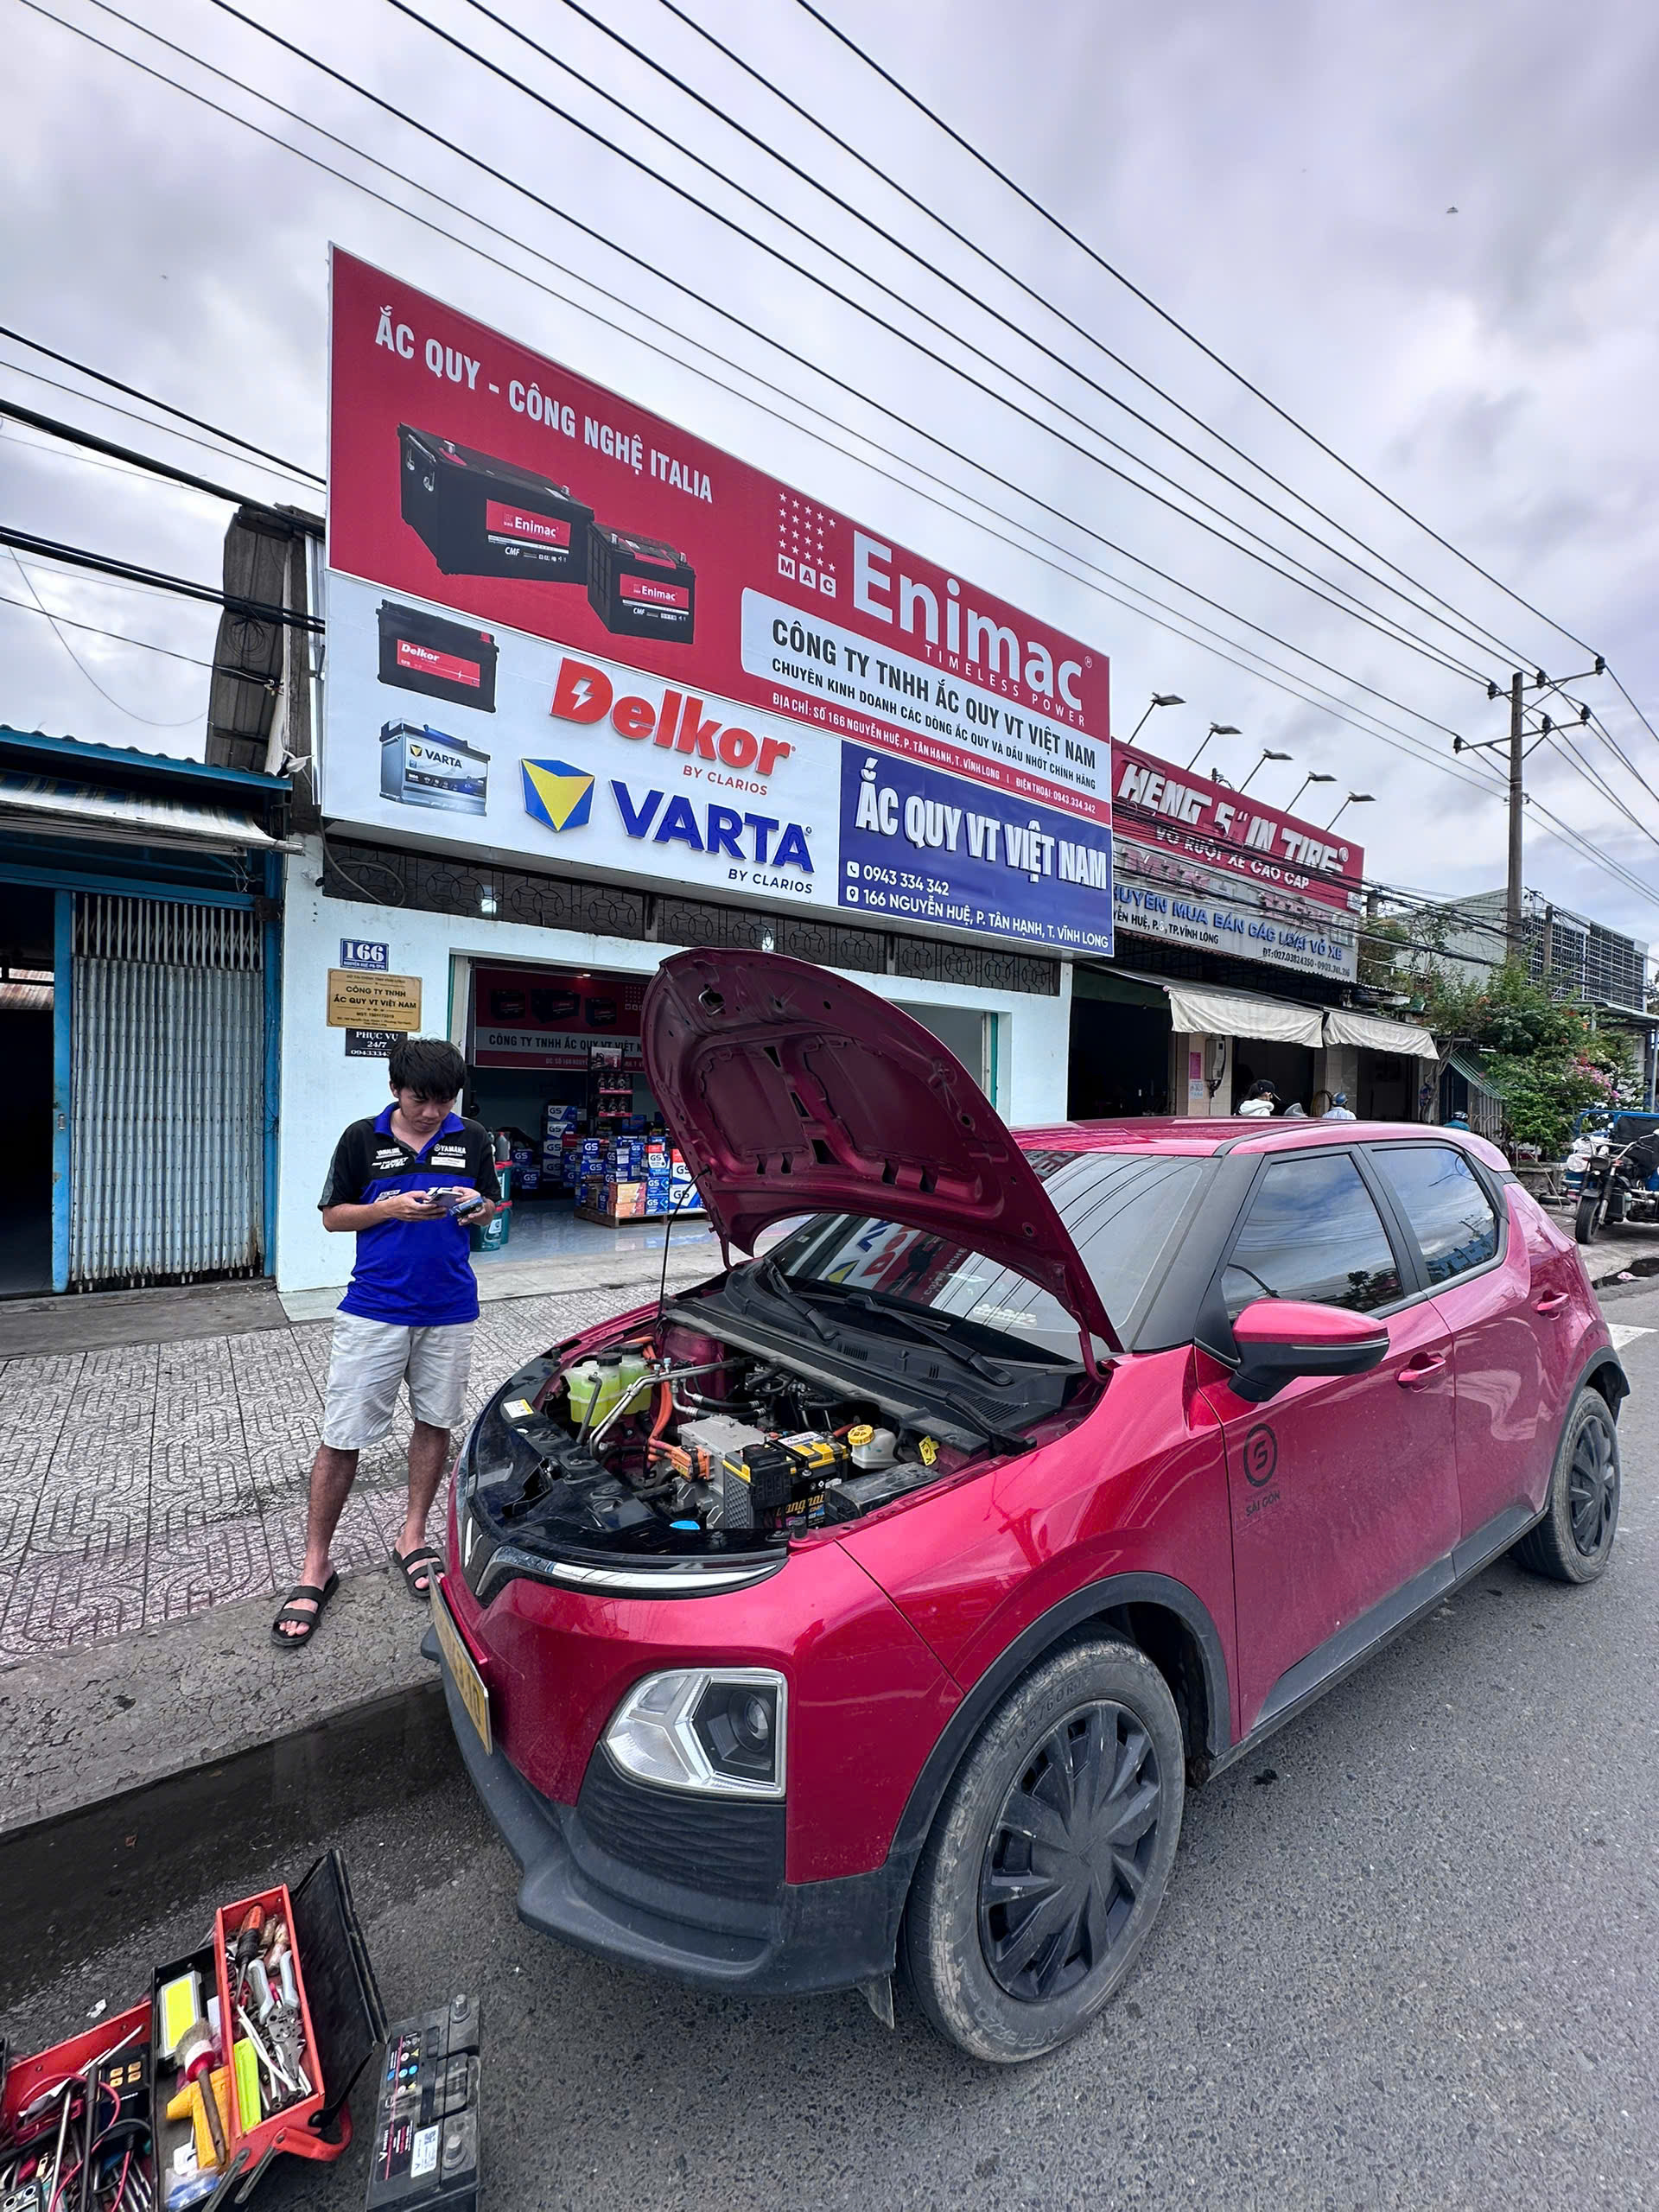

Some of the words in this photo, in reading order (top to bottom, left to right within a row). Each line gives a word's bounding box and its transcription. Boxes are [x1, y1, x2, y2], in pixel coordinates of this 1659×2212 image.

[375, 304, 415, 359] ẮC
[425, 338, 481, 391] QUY
[509, 379, 575, 438] CÔNG
[584, 415, 643, 475] NGHỆ
[651, 448, 713, 504] ITALIA
[514, 516, 556, 537] Enimac
[779, 557, 835, 594] MAC
[641, 585, 676, 601] Enimac
[854, 530, 1083, 711] Enimac
[401, 643, 440, 662] Delkor
[772, 619, 836, 666] CÔNG
[844, 646, 870, 677] TY
[876, 659, 929, 702] TNHH
[935, 678, 959, 713] ẮC
[965, 697, 1000, 729] QUY
[1004, 713, 1024, 739] VT
[1028, 723, 1061, 756] VIỆT
[1065, 738, 1096, 770] NAM
[925, 644, 1019, 697] TIMELESS
[1032, 694, 1085, 727] POWER
[550, 657, 791, 776] Delkor
[772, 658, 823, 688] CHUYÊN
[827, 677, 855, 700] KINH
[859, 690, 897, 715] DOANH
[900, 702, 922, 724] CÁC
[925, 714, 952, 732] DÒNG
[955, 722, 968, 741] ẮC
[970, 732, 989, 749] QUY
[991, 739, 1004, 755] VÀ
[1006, 745, 1023, 762] DẦU
[1025, 753, 1047, 771] NHỚT
[1049, 763, 1074, 782] CHÍNH
[424, 748, 462, 768] VARTA
[772, 692, 790, 710] ĐỊA
[791, 698, 812, 716] CHỈ:
[813, 706, 826, 721] SỐ
[828, 711, 845, 728] 166
[847, 720, 882, 740] NGUYỄN
[883, 731, 903, 748] HUỆ,
[904, 738, 912, 750] P.
[913, 741, 930, 756] TÂN
[930, 746, 954, 765] HẠNH,
[955, 756, 963, 767] T.
[963, 758, 981, 773] VĨNH
[982, 765, 1000, 780] LONG
[1015, 777, 1032, 791] ĐIỆN
[1032, 782, 1053, 798] THOẠI:
[1053, 791, 1096, 815] 0943.334.342
[683, 765, 702, 778] BY
[707, 771, 768, 796] CLARIOS
[609, 779, 815, 874] VARTA
[855, 756, 899, 836] ẮC
[905, 795, 962, 852] QUY
[965, 811, 1001, 861] VT
[1004, 819, 1055, 883] VIỆT
[1058, 839, 1107, 890] NAM
[1281, 827, 1344, 874] TIRE
[728, 868, 748, 881] BY
[752, 873, 813, 894] CLARIOS
[863, 864, 897, 885] 0943
[899, 872, 925, 891] 334
[926, 878, 950, 896] 342
[1250, 861, 1281, 880] CAO
[863, 888, 887, 906] 166
[889, 893, 944, 917] NGUYỄN
[946, 904, 974, 925] HUỆ,
[976, 912, 986, 925] P.
[988, 911, 1010, 930] TÂN
[1013, 918, 1045, 938] HẠNH,
[1046, 925, 1055, 938] T.
[1058, 925, 1080, 943] VĨNH
[1082, 931, 1109, 949] LONG
[1113, 884, 1167, 914] HUYÊN
[1172, 900, 1208, 925] MUA
[1213, 910, 1244, 934] BÁN
[1249, 921, 1276, 942] CÁC
[1279, 931, 1306, 952] LOẠI
[1310, 938, 1326, 956] VỎ
[1328, 945, 1343, 961] XE
[1131, 913, 1150, 931] HUỆ,
[1199, 931, 1219, 945] LONG
[346, 942, 385, 962] 166
[334, 994, 346, 1002] ẮC
[380, 998, 397, 1007] VIỆT
[355, 1031, 383, 1040] PHỤC
[385, 1033, 399, 1041] VỤ
[489, 1032, 518, 1046] CÔNG
[520, 1036, 532, 1047] TY
[535, 1038, 562, 1049] TNHH
[564, 1035, 577, 1050] ẮC
[580, 1039, 599, 1051] QUY
[441, 1145, 467, 1154] YAMAHA
[547, 1143, 562, 1152] GS
[584, 1142, 598, 1151] GS
